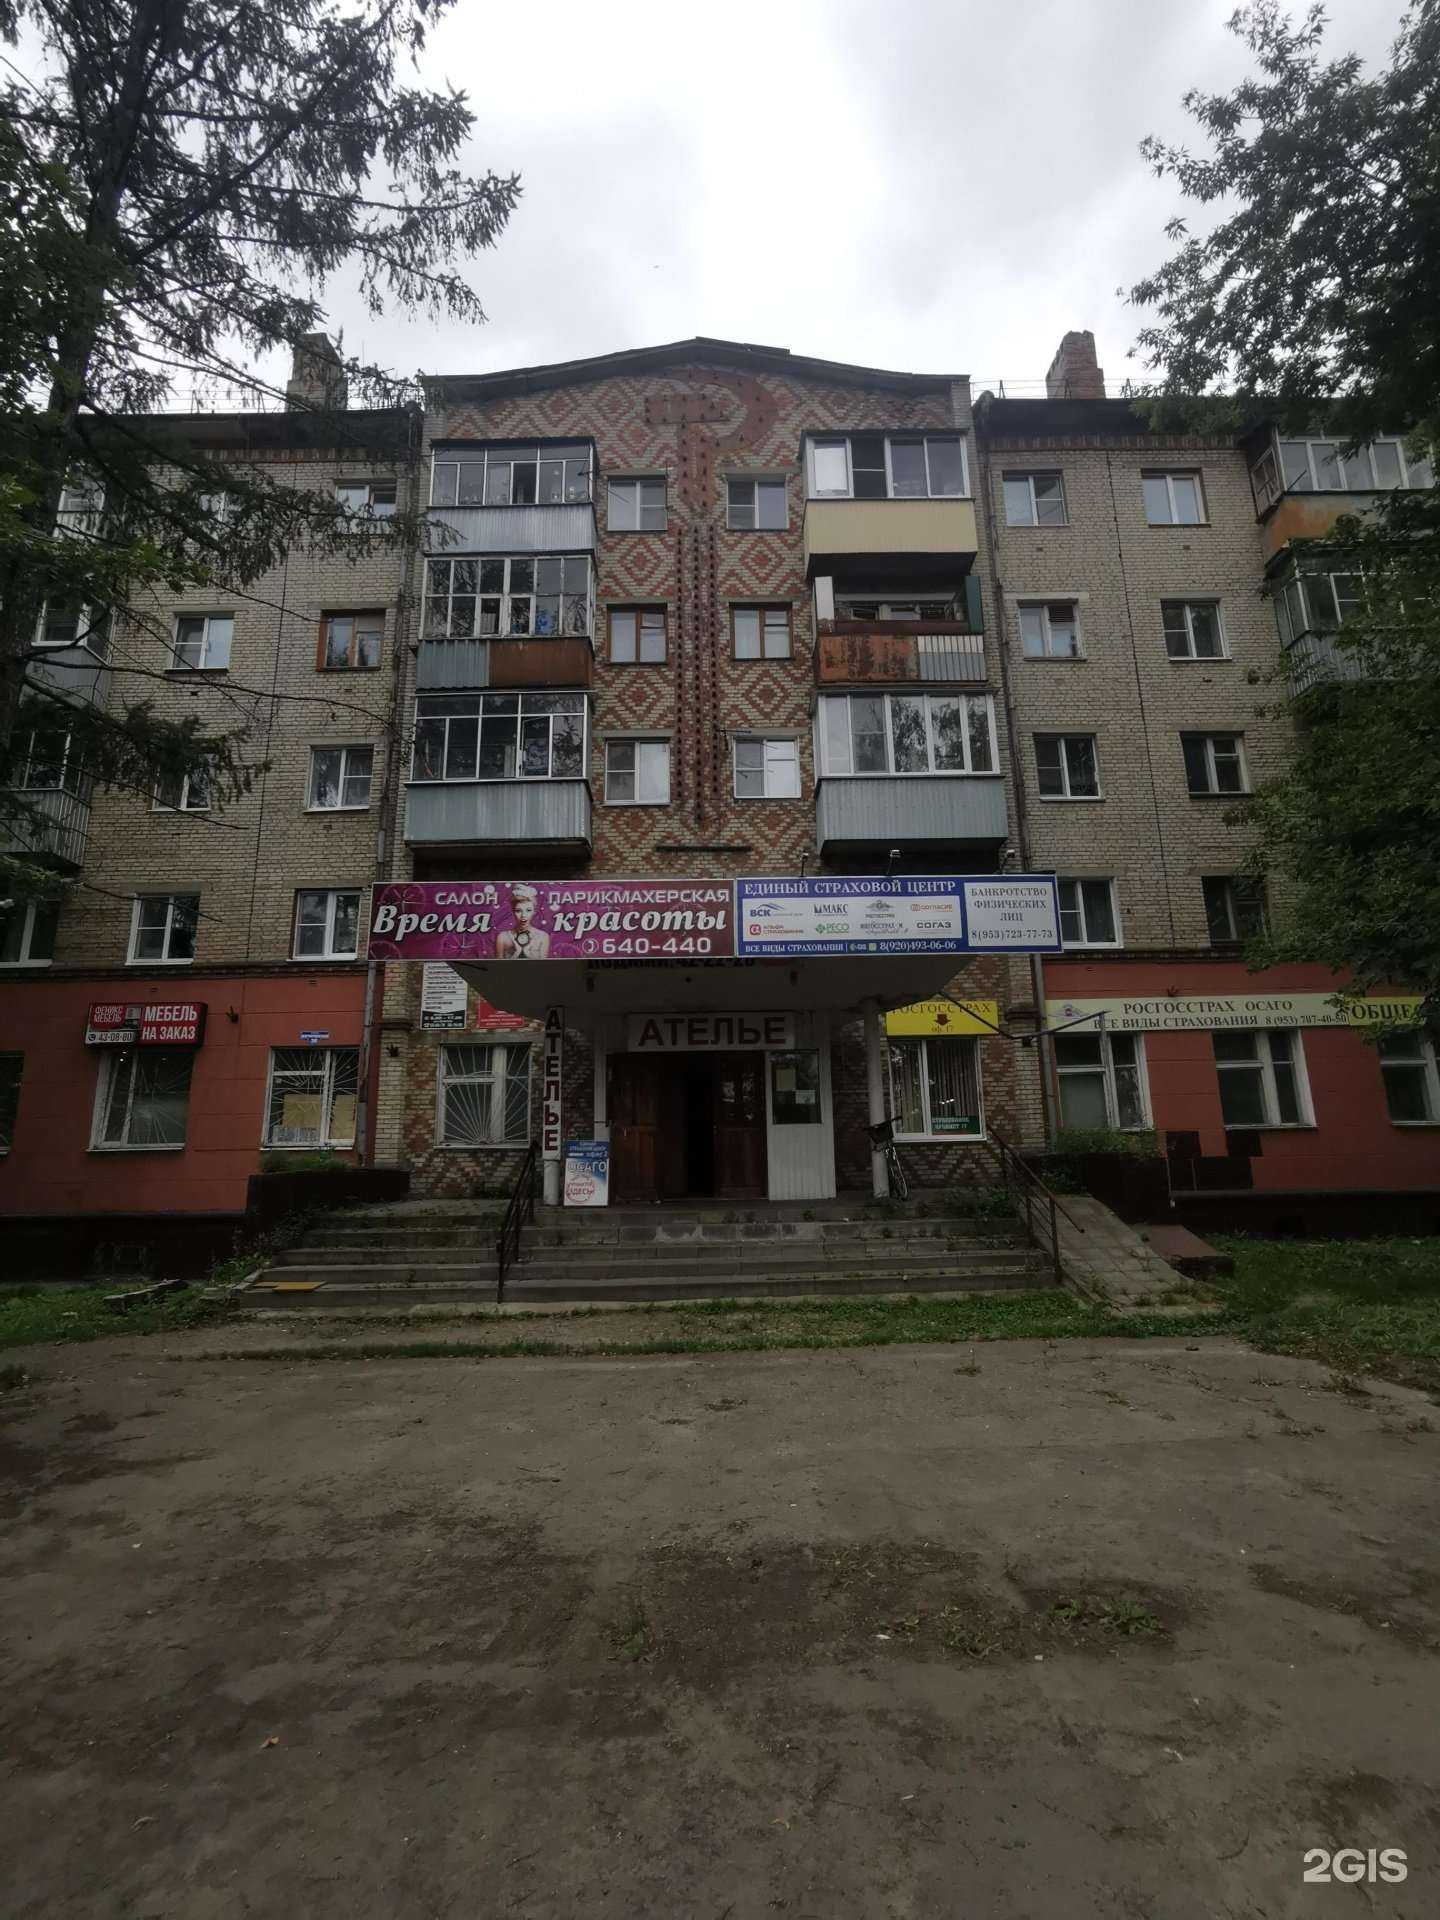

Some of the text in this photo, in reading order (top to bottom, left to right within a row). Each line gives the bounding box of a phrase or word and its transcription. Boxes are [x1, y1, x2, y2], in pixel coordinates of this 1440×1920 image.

[744, 879, 956, 896] ЕДИНЫЙ СТРАХОВОЙ ЦЕНТР
[971, 887, 1047, 897] БАНКРОТСТВО
[435, 891, 499, 905] САЛОН
[549, 889, 730, 905] ПАРИКМАХЕРСКАЯ
[823, 903, 849, 914] МАКС
[973, 899, 1047, 910] ФИЗИЧЕСКИХ
[750, 909, 772, 917] ВСК
[1000, 912, 1024, 921] ЛИЦ
[372, 904, 727, 940] Время красоты
[916, 921, 952, 929] СОГАЗ
[602, 938, 712, 954] 640-440
[745, 944, 760, 953] ВСЕ
[762, 944, 785, 953] ВИДЫ
[144, 1005, 198, 1022] МЕБЕЛЬ
[1123, 1000, 1293, 1015] РОСГОССТРАХ ОСАГО
[1122, 1018, 1160, 1029] ВИДЫ
[1163, 1015, 1258, 1027] СТРАХОВАНИЯ
[1265, 1016, 1272, 1026] 8
[142, 1025, 196, 1040] НА ЗАКАЗ
[638, 1016, 787, 1047] АТЕЛЬЕ
[544, 1009, 562, 1152] АТЕЛЬЕ
